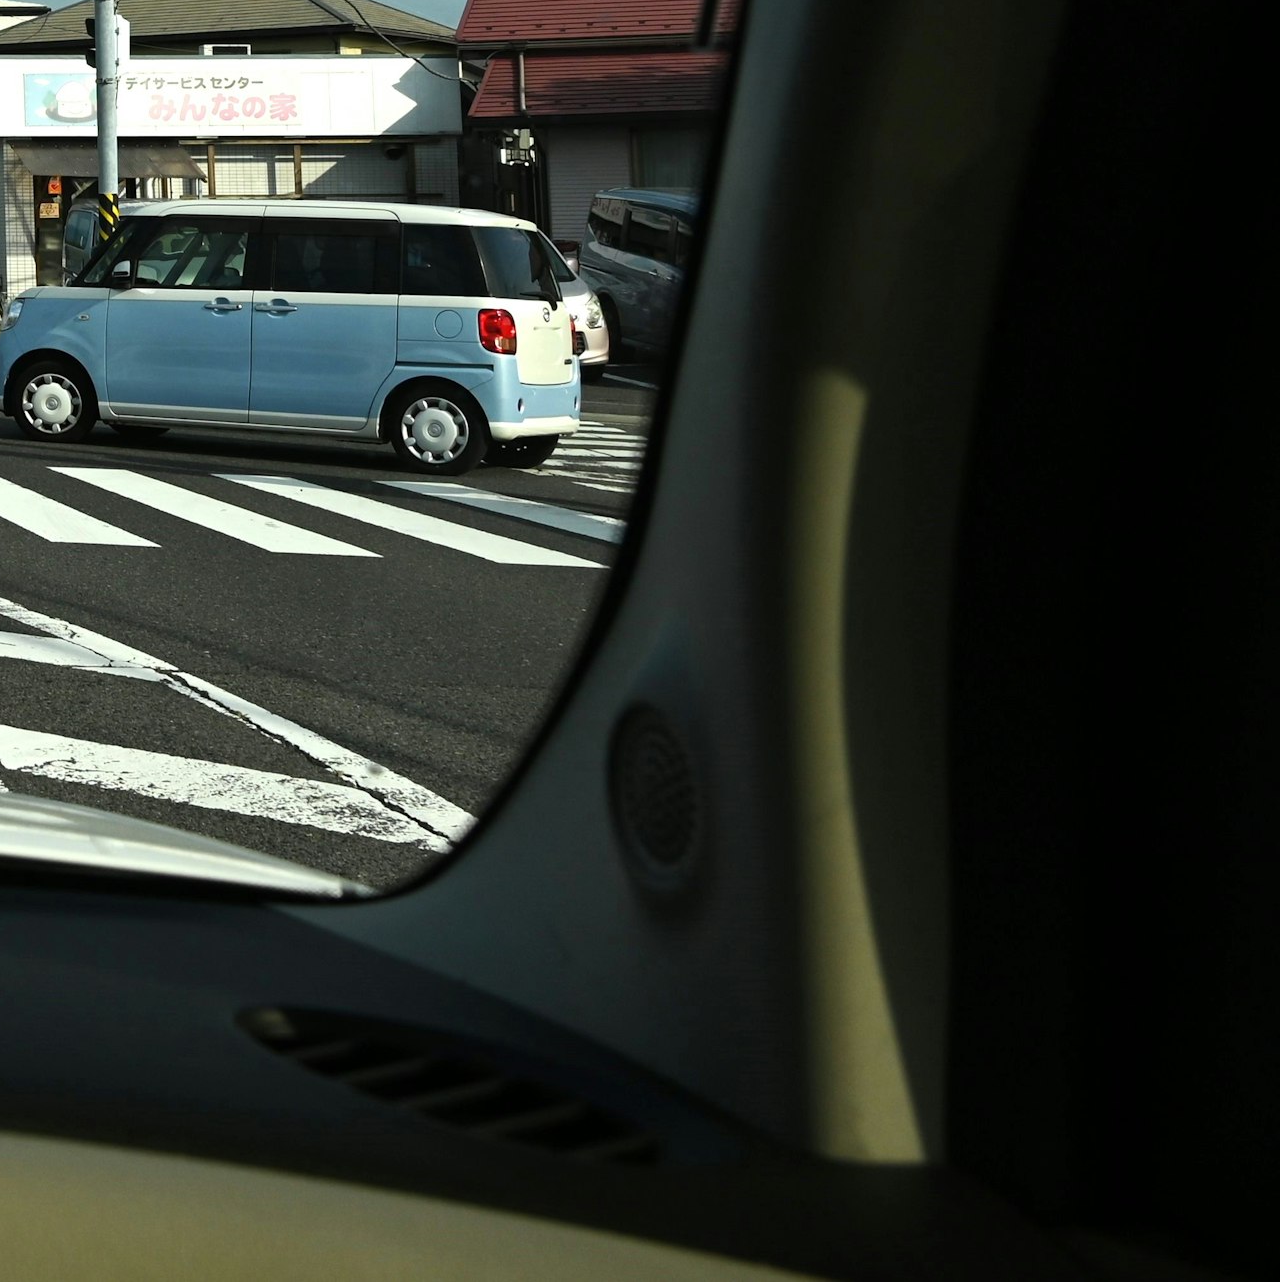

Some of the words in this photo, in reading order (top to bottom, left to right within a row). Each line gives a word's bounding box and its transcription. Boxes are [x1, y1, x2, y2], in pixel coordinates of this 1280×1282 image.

[148, 93, 298, 122] みんなの家
